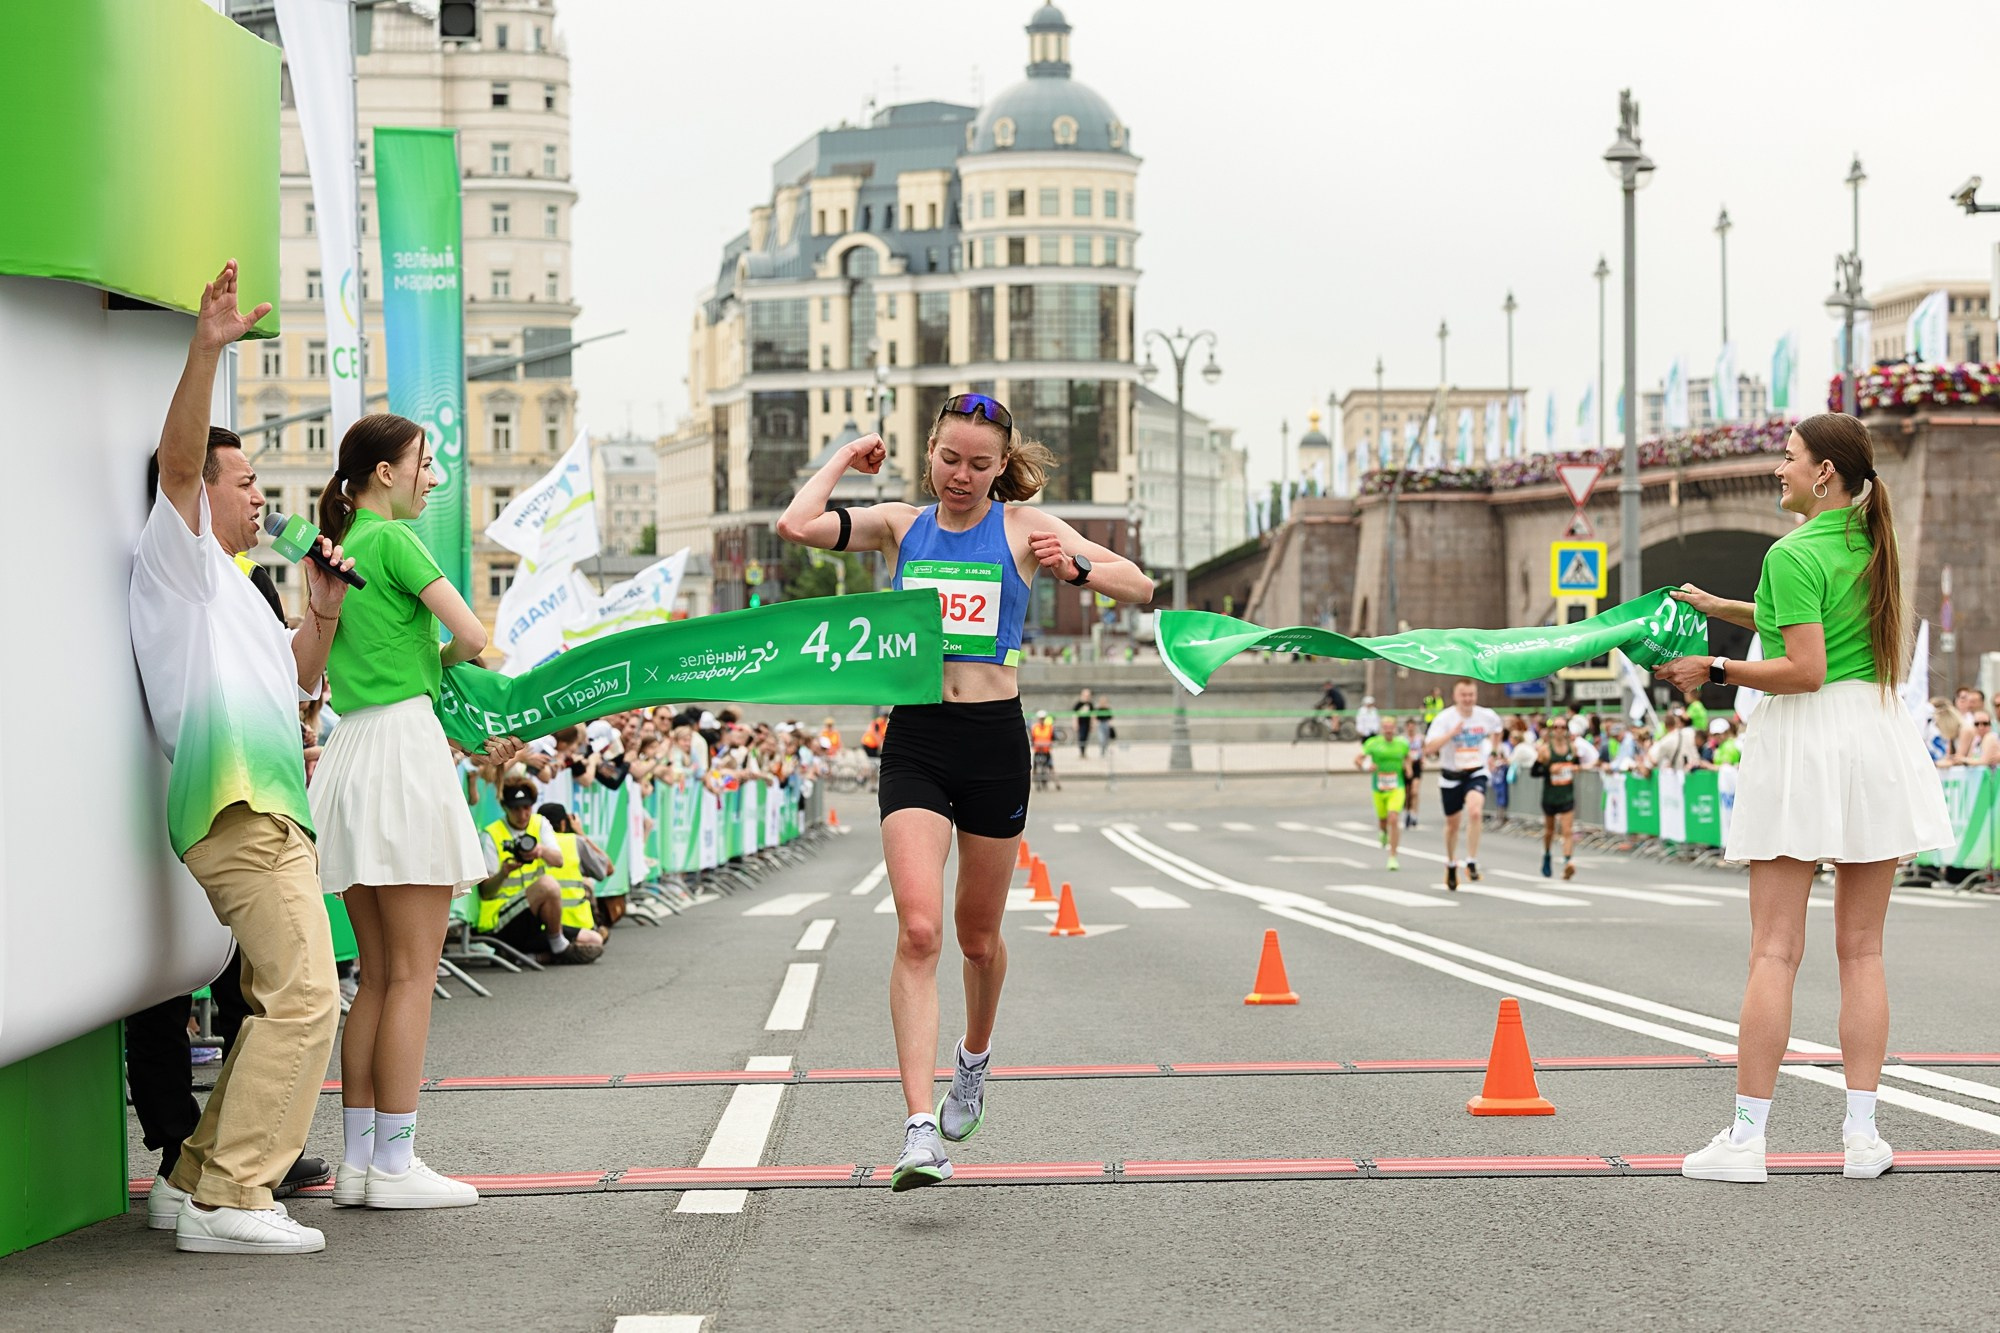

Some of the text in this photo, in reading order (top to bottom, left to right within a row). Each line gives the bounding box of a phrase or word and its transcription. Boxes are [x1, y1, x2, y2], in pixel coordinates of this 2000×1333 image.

[679, 645, 747, 668] зелёный
[800, 616, 872, 672] 4,2
[666, 664, 737, 683] марафон
[556, 678, 619, 709] Прайм
